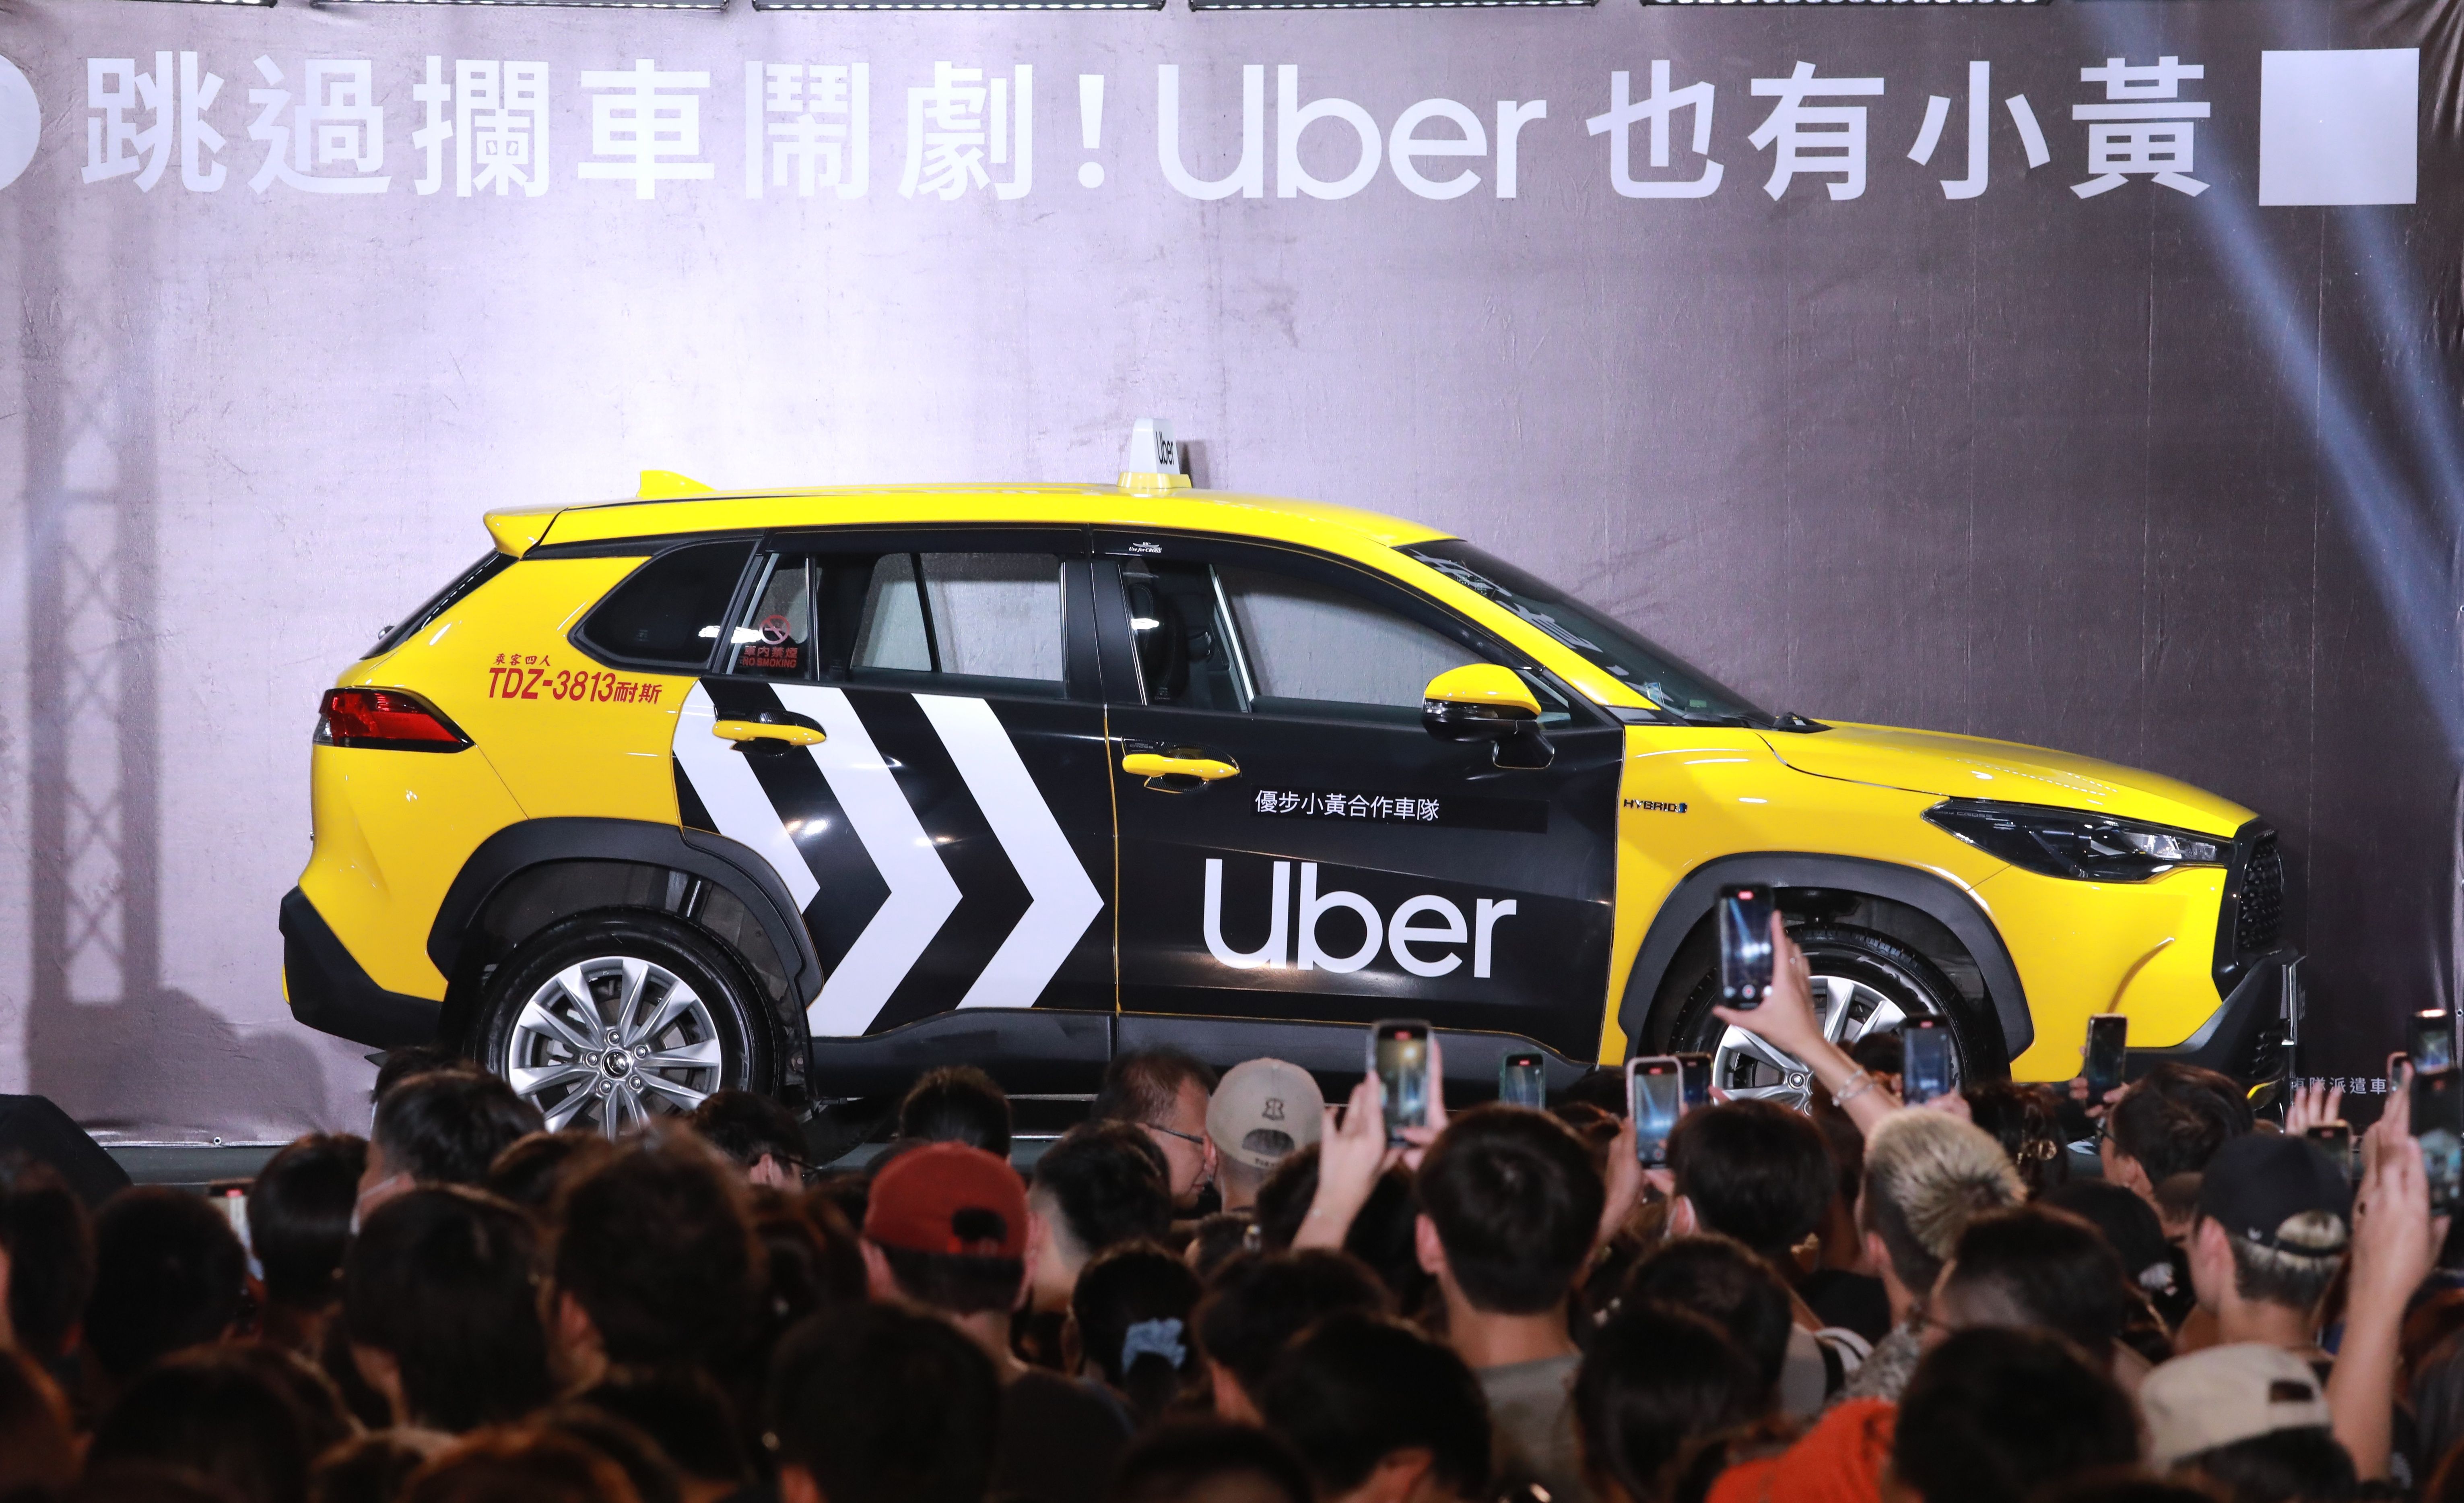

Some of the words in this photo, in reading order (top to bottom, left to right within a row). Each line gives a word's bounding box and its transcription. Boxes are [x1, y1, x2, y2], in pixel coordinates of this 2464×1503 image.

[1158, 64, 1547, 200] Uber
[1586, 56, 2210, 201] 也有小黃
[1155, 431, 1174, 465] Uber
[493, 653, 551, 667] 乘客四人
[743, 657, 755, 667] NO
[757, 658, 797, 668] SMOKING
[1255, 790, 1439, 821] 優步小黃合作車隊
[1623, 798, 1677, 812] HYBRID
[1203, 858, 1517, 978] Uber
